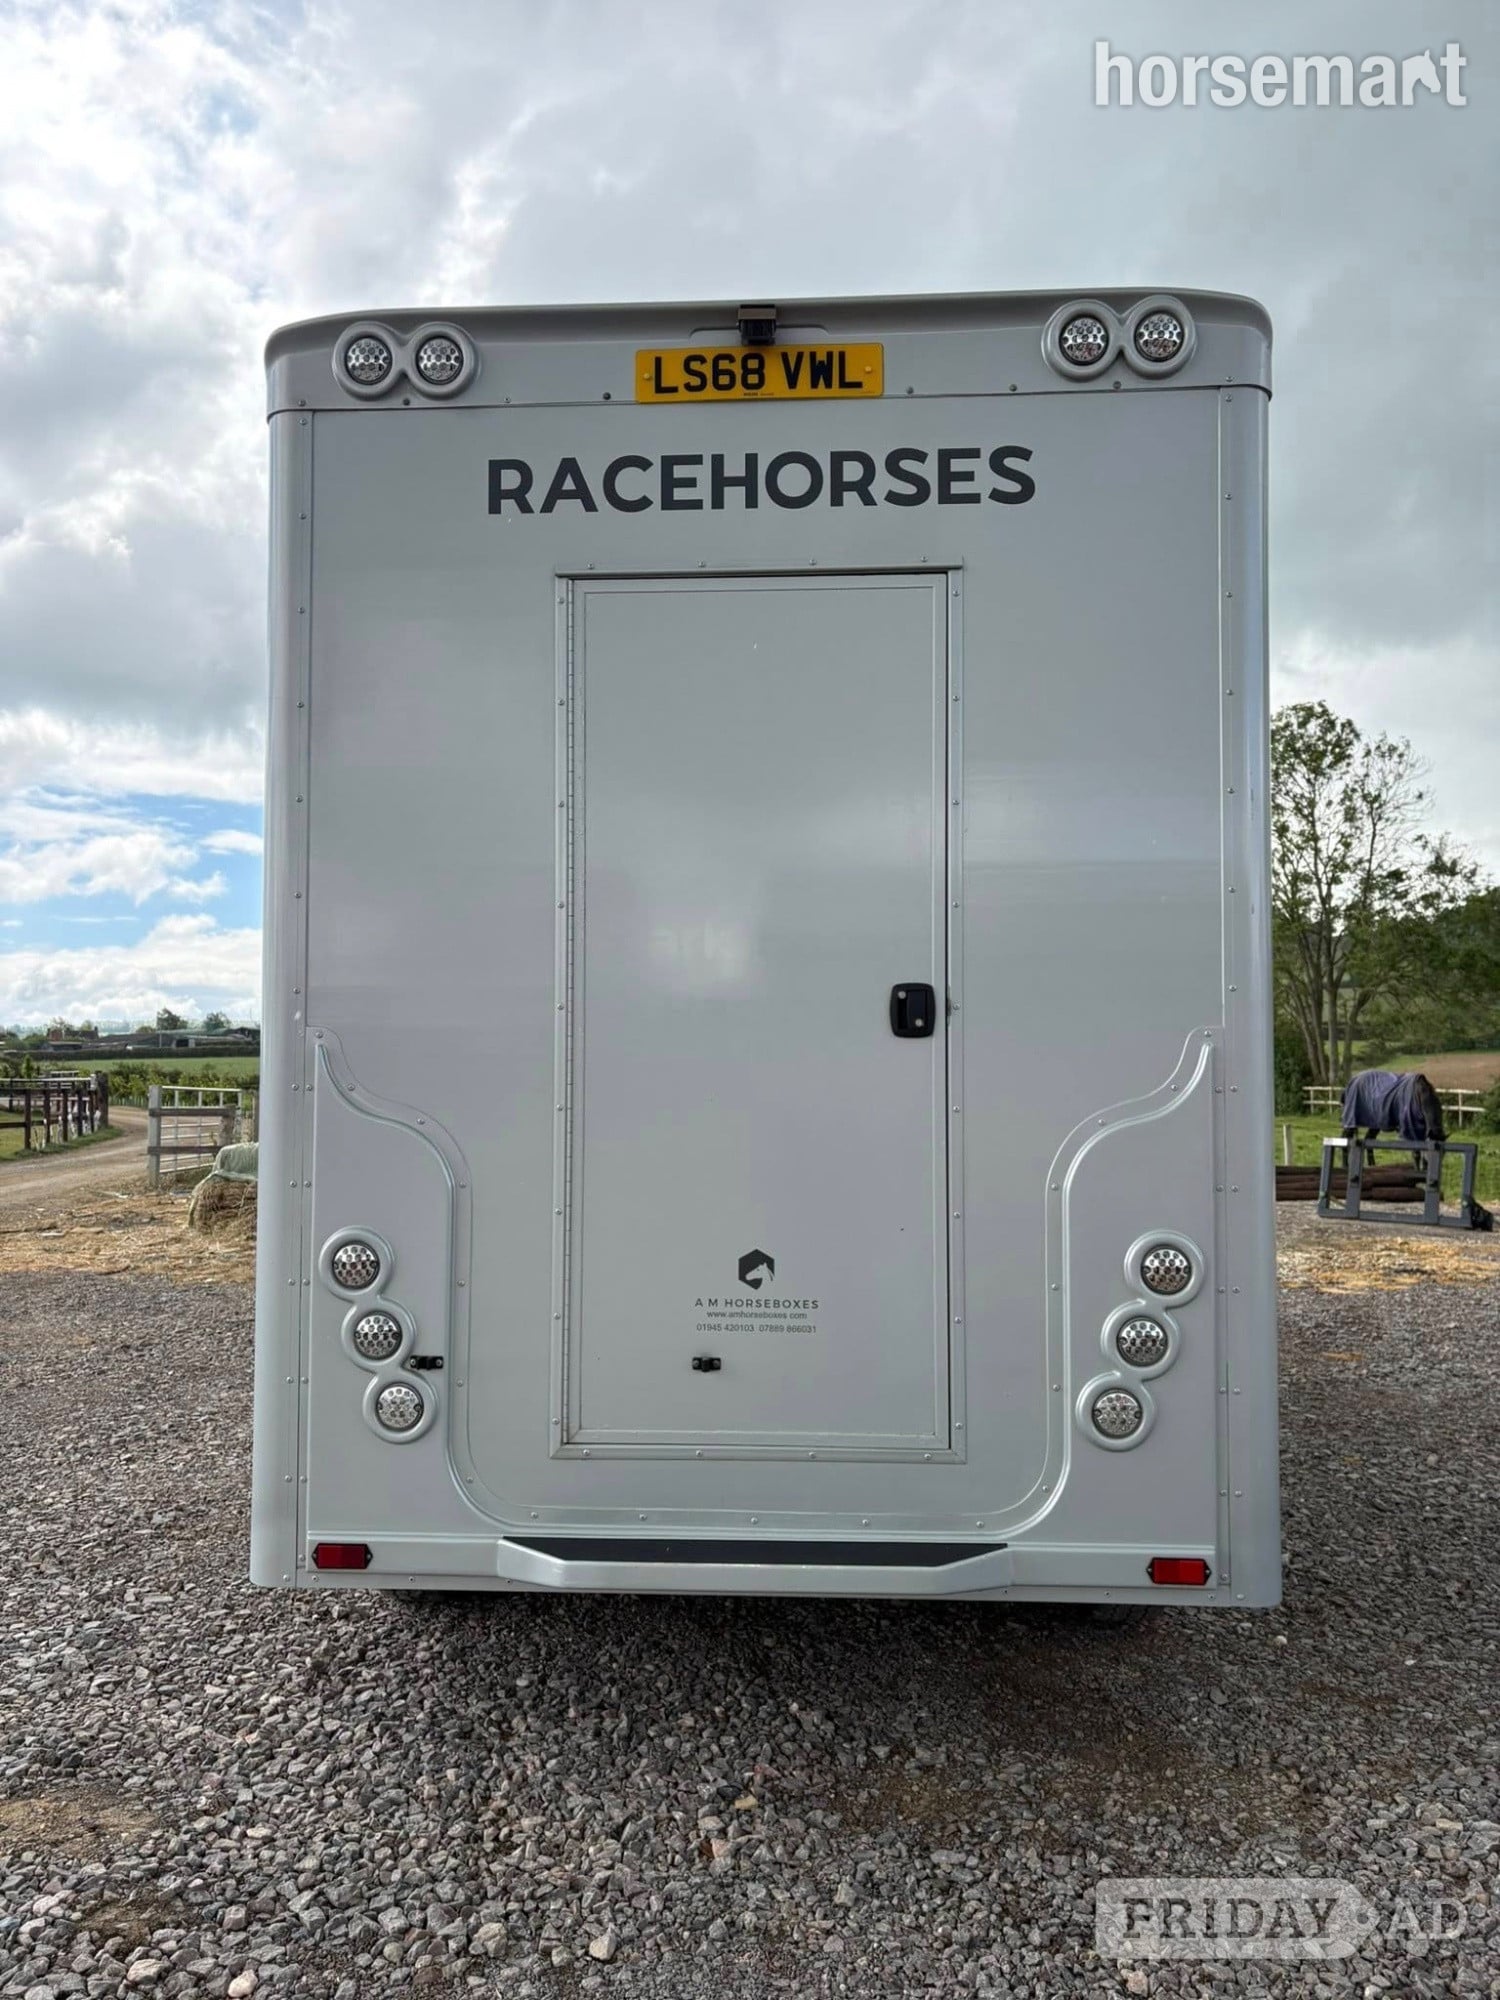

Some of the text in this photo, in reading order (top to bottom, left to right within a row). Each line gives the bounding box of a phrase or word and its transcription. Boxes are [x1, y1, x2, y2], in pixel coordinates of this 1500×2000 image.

[654, 351, 864, 394] LS68 VWL
[487, 444, 1037, 516] RACEHORSES
[694, 1298, 820, 1310] A M HORSEBOXES
[696, 1323, 722, 1332] 01945
[724, 1323, 755, 1333] 420103
